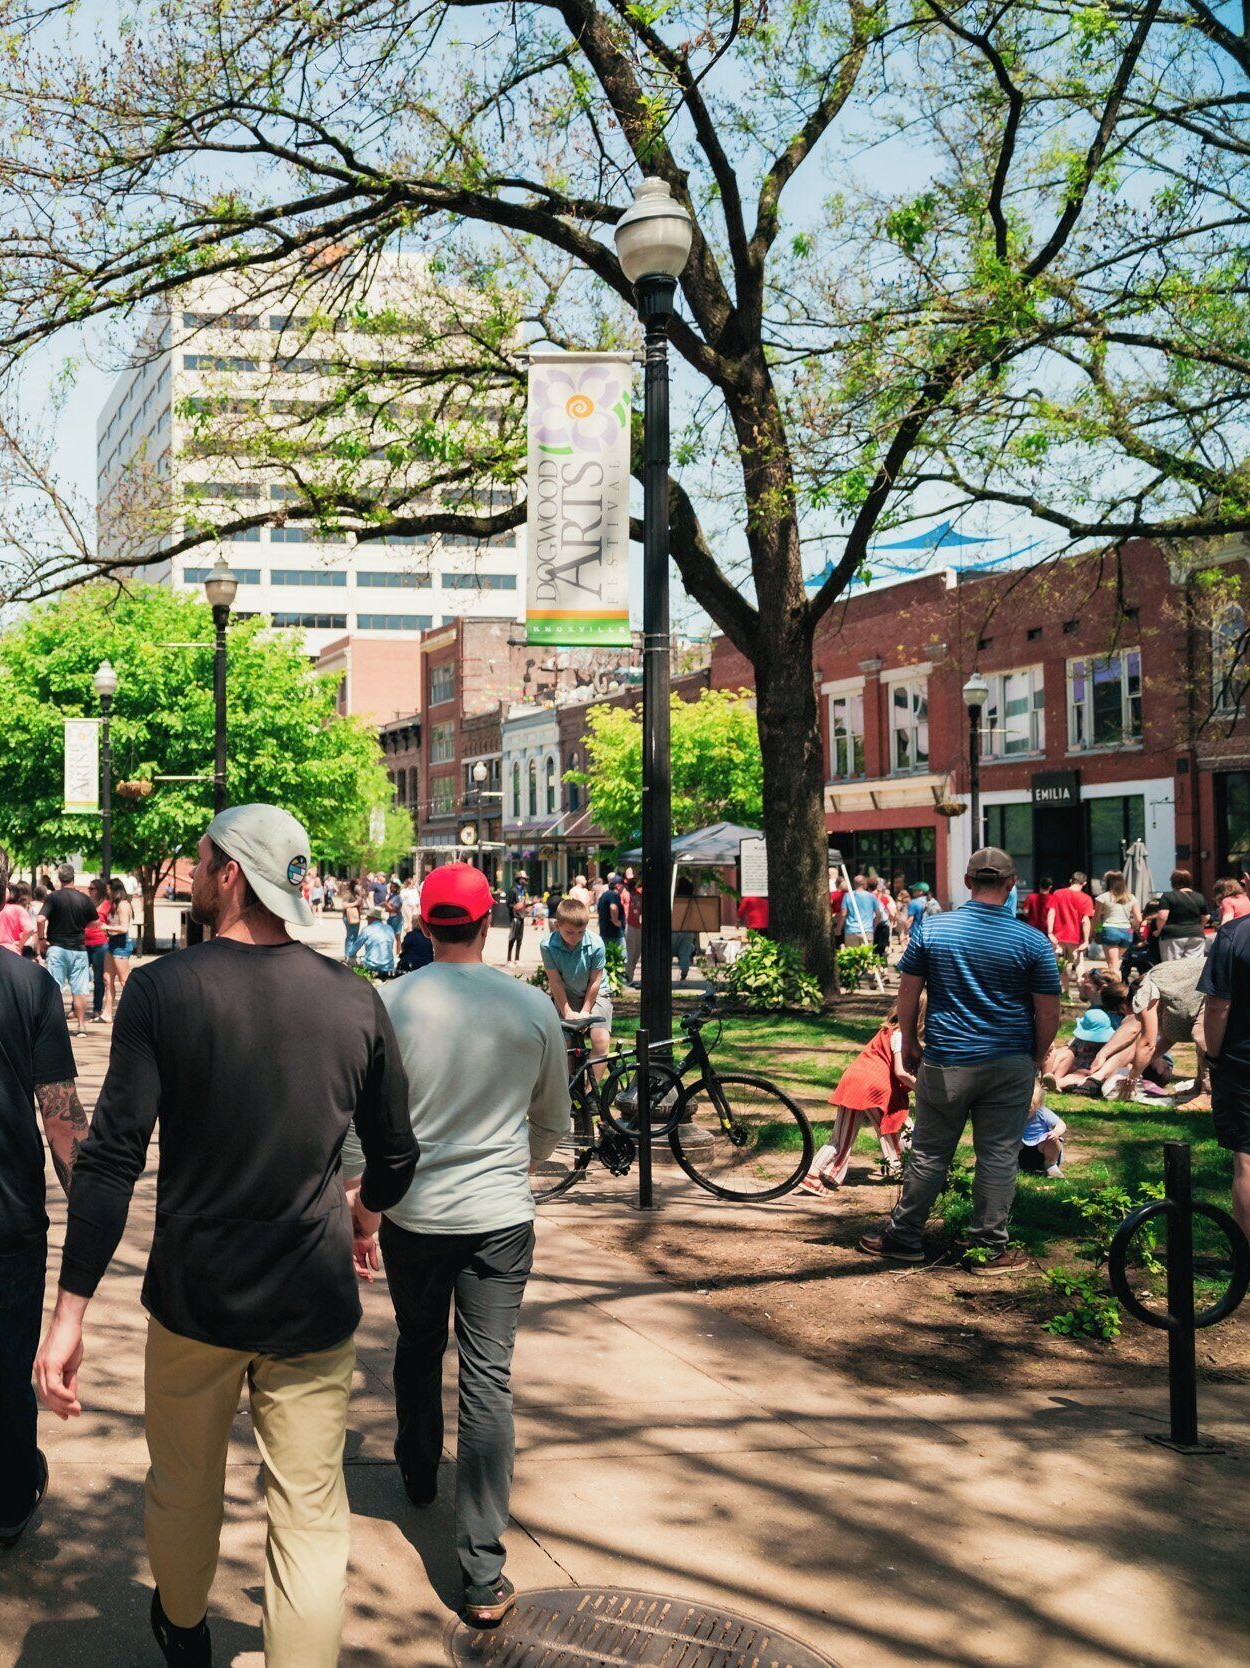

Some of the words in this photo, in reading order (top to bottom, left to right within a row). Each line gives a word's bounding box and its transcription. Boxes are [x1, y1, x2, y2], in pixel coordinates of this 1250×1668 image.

[537, 460, 559, 601] DOGWOOD
[545, 460, 604, 601] ARTS
[607, 461, 620, 605] FESTIVAL
[1035, 787, 1071, 801] EMILIA
